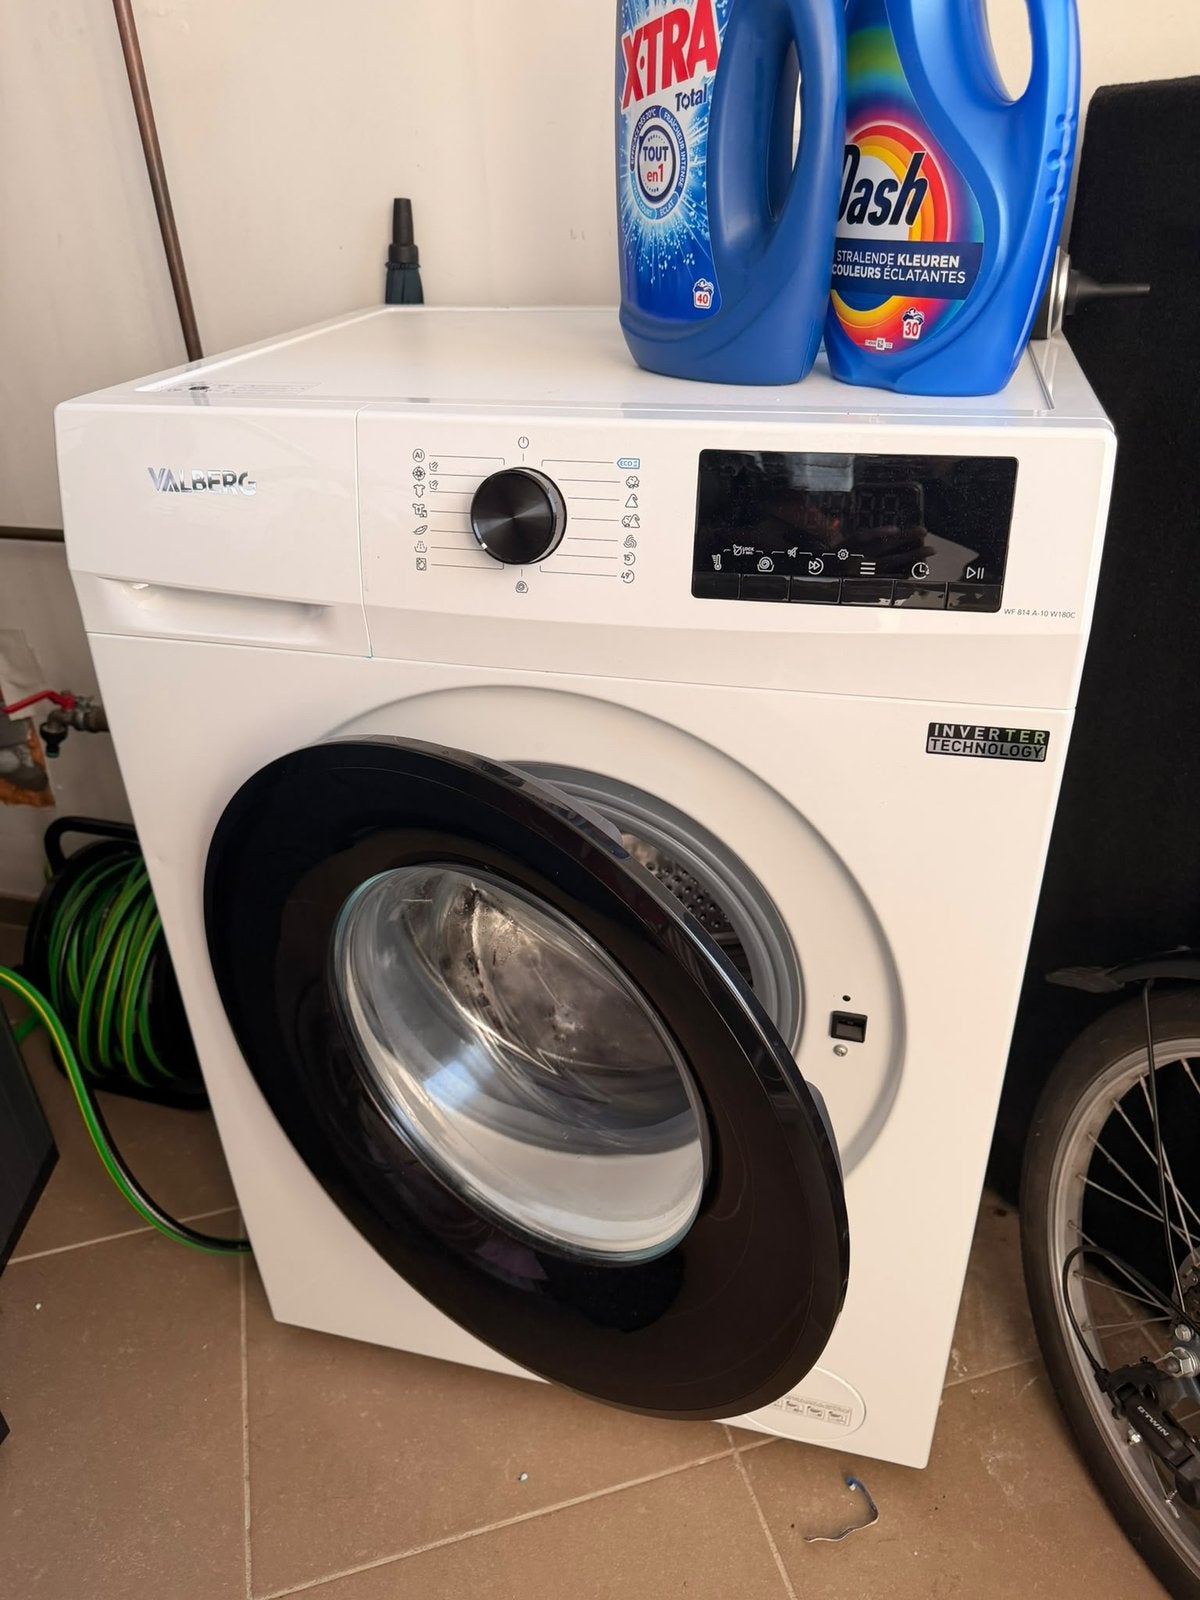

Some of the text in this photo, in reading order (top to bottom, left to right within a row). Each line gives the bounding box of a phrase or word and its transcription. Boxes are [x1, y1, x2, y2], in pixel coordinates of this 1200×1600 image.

[674, 83, 708, 112] Total
[643, 146, 669, 161] TOUT
[678, 151, 687, 188] INTENSE
[836, 250, 960, 268] STRALENDE KLEUREN
[832, 263, 966, 284] COULEURS ÉCLATANTES
[696, 294, 709, 304] 40
[905, 321, 919, 337] 30
[147, 467, 257, 496] VALBERG
[1017, 608, 1030, 616] 814
[934, 724, 1046, 744] INVERTER
[930, 738, 1044, 759] TECHNOLOGY
